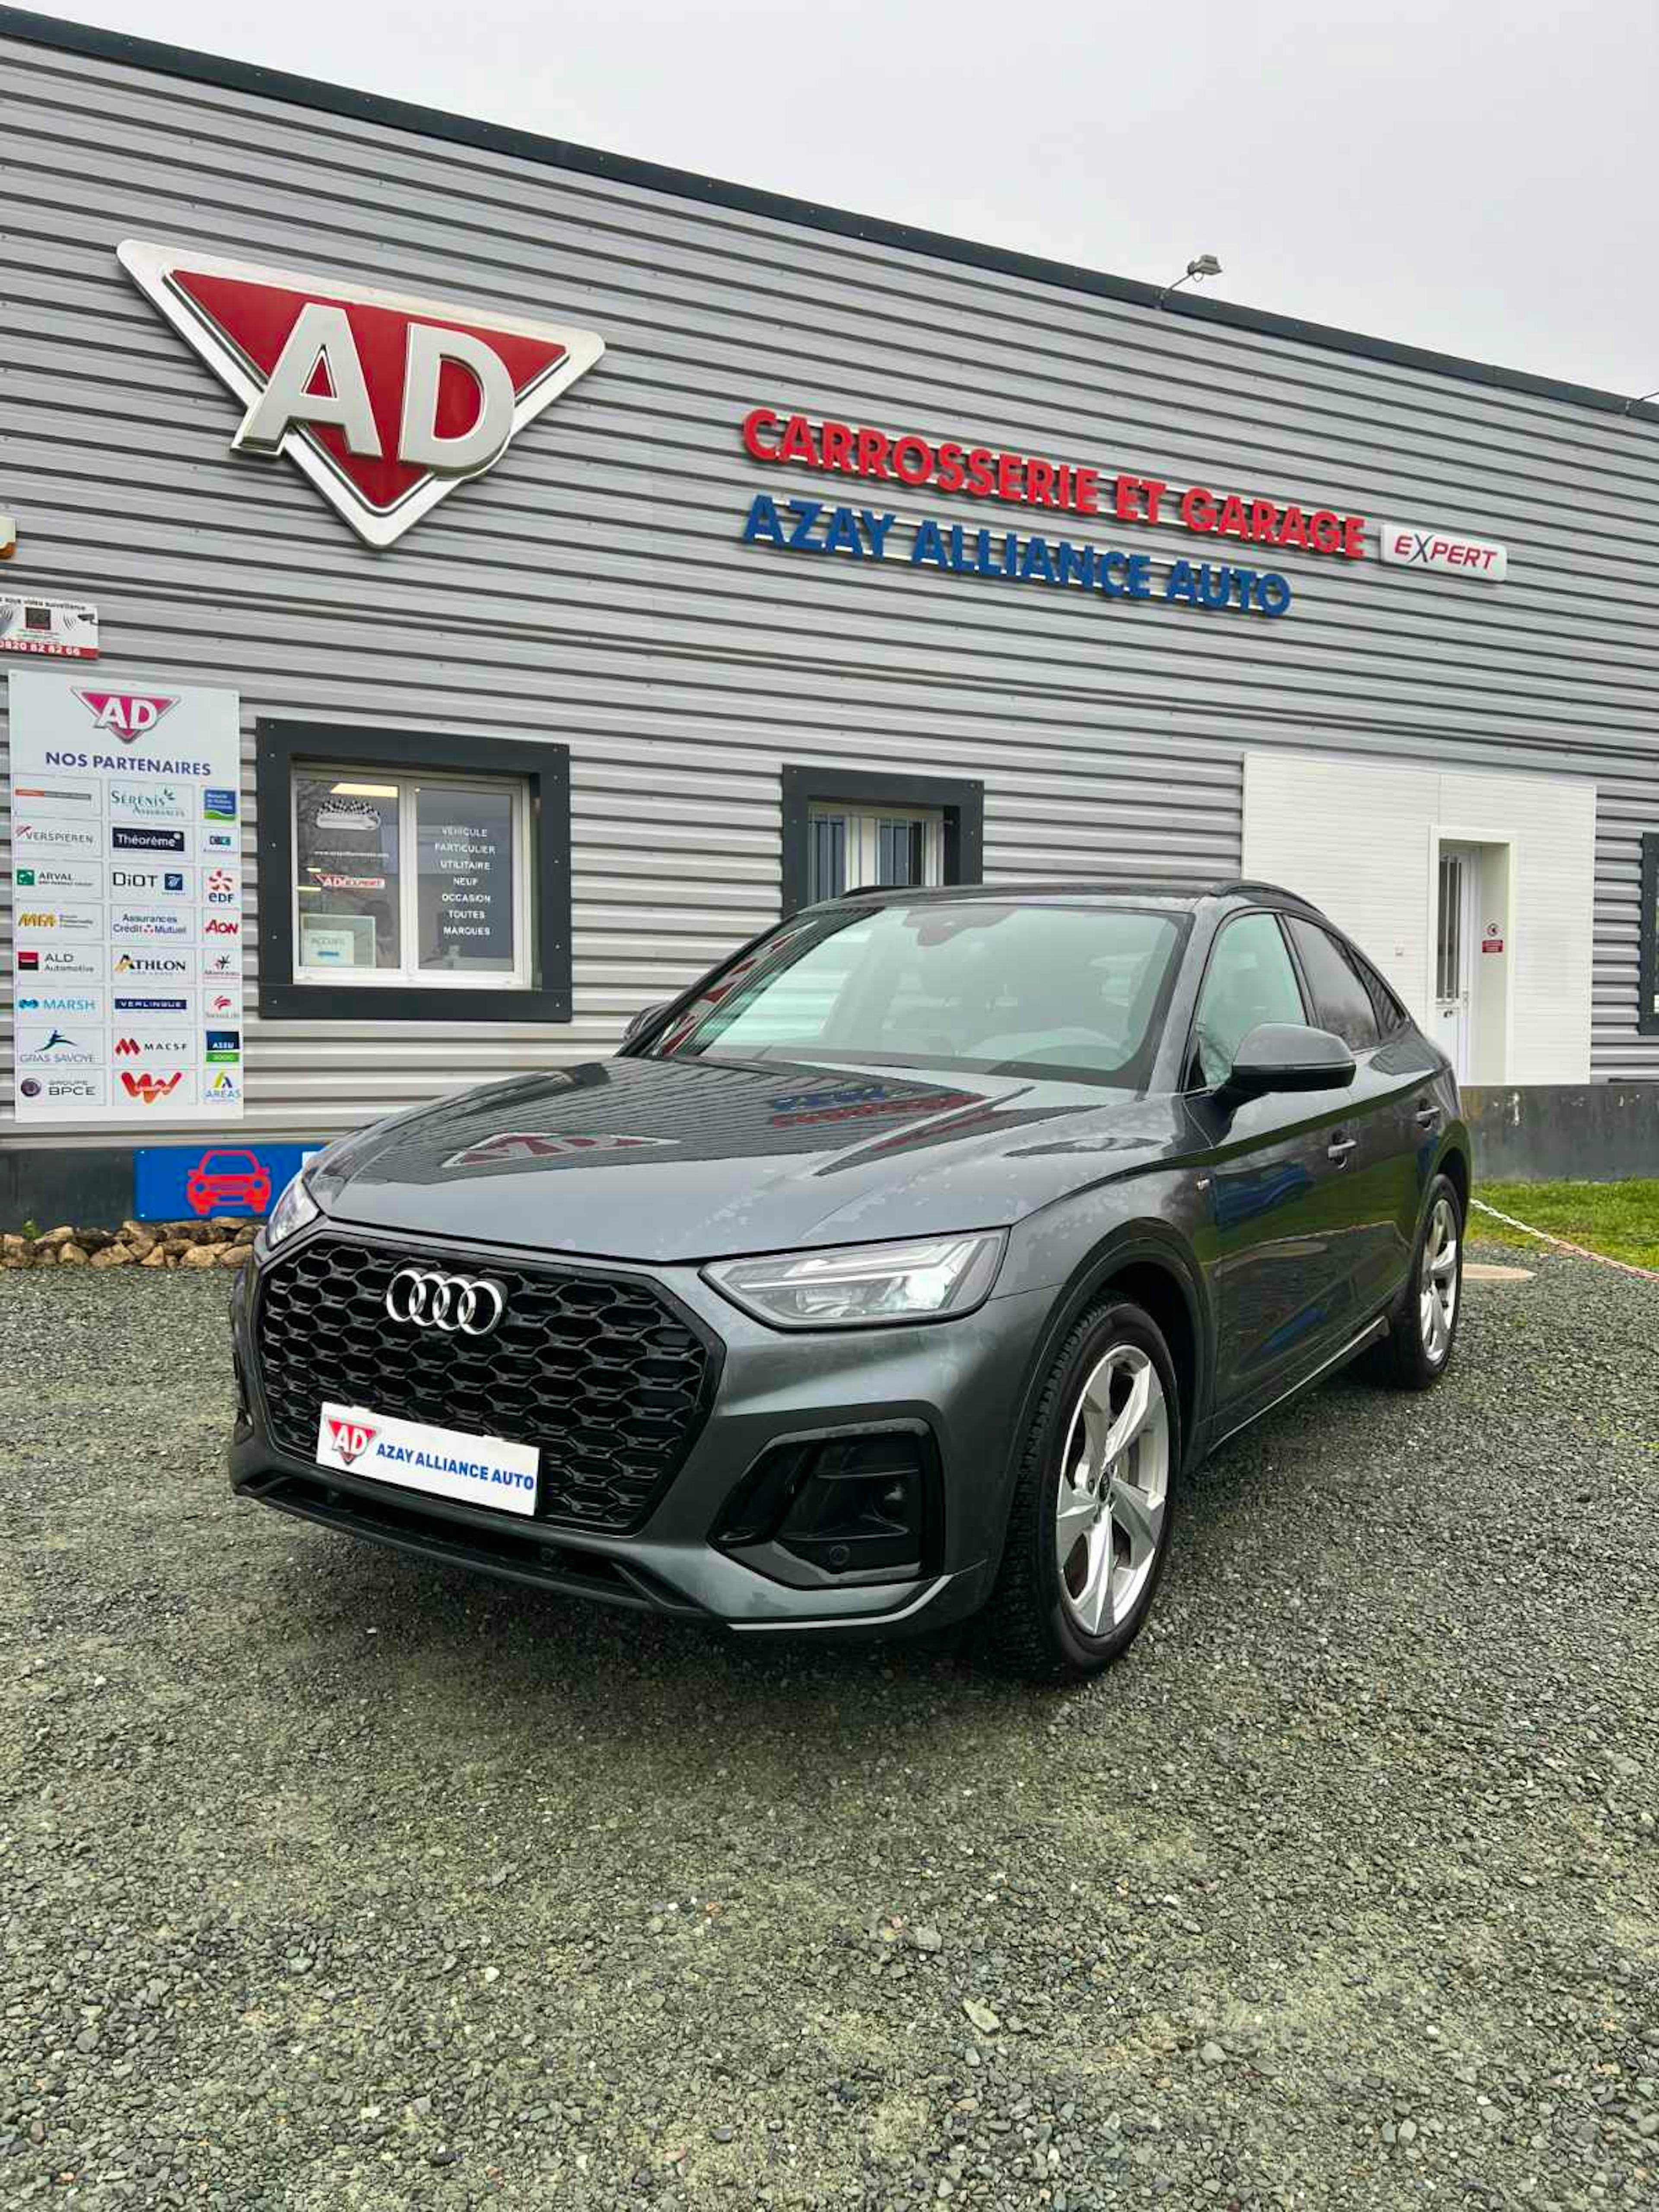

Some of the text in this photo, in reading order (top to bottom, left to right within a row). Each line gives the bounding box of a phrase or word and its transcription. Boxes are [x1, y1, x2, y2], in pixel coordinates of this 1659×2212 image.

[230, 302, 516, 480] AD
[742, 410, 1366, 559] CARROSSERIE ET GARAGE
[744, 496, 1291, 618] AZAY ALLIANCE AUTO
[1394, 534, 1497, 569] EXPERT
[94, 696, 158, 730] AD
[45, 752, 211, 776] NOS PARTENAIRES
[26, 832, 93, 843] VERSPIEREN
[116, 833, 176, 847] Théorème
[435, 843, 496, 855] PARTICULIER
[440, 861, 491, 870] UTILITAIRE
[39, 873, 71, 881] ARVAL
[453, 877, 478, 886] NEUF
[442, 893, 491, 903] OCCASION
[123, 914, 178, 922] Assurances
[448, 910, 485, 919] TOUTES
[154, 925, 187, 934] Mutuel
[443, 926, 491, 936] MARQUES
[44, 953, 73, 963] ALD
[114, 954, 186, 972] ATHLON
[43, 999, 95, 1010] MARSH
[21, 1053, 96, 1062] GRAS SAVOYE
[48, 1086, 95, 1096] BPCE
[332, 1425, 534, 1491] AD AZAY ALLIANCE AUTO
